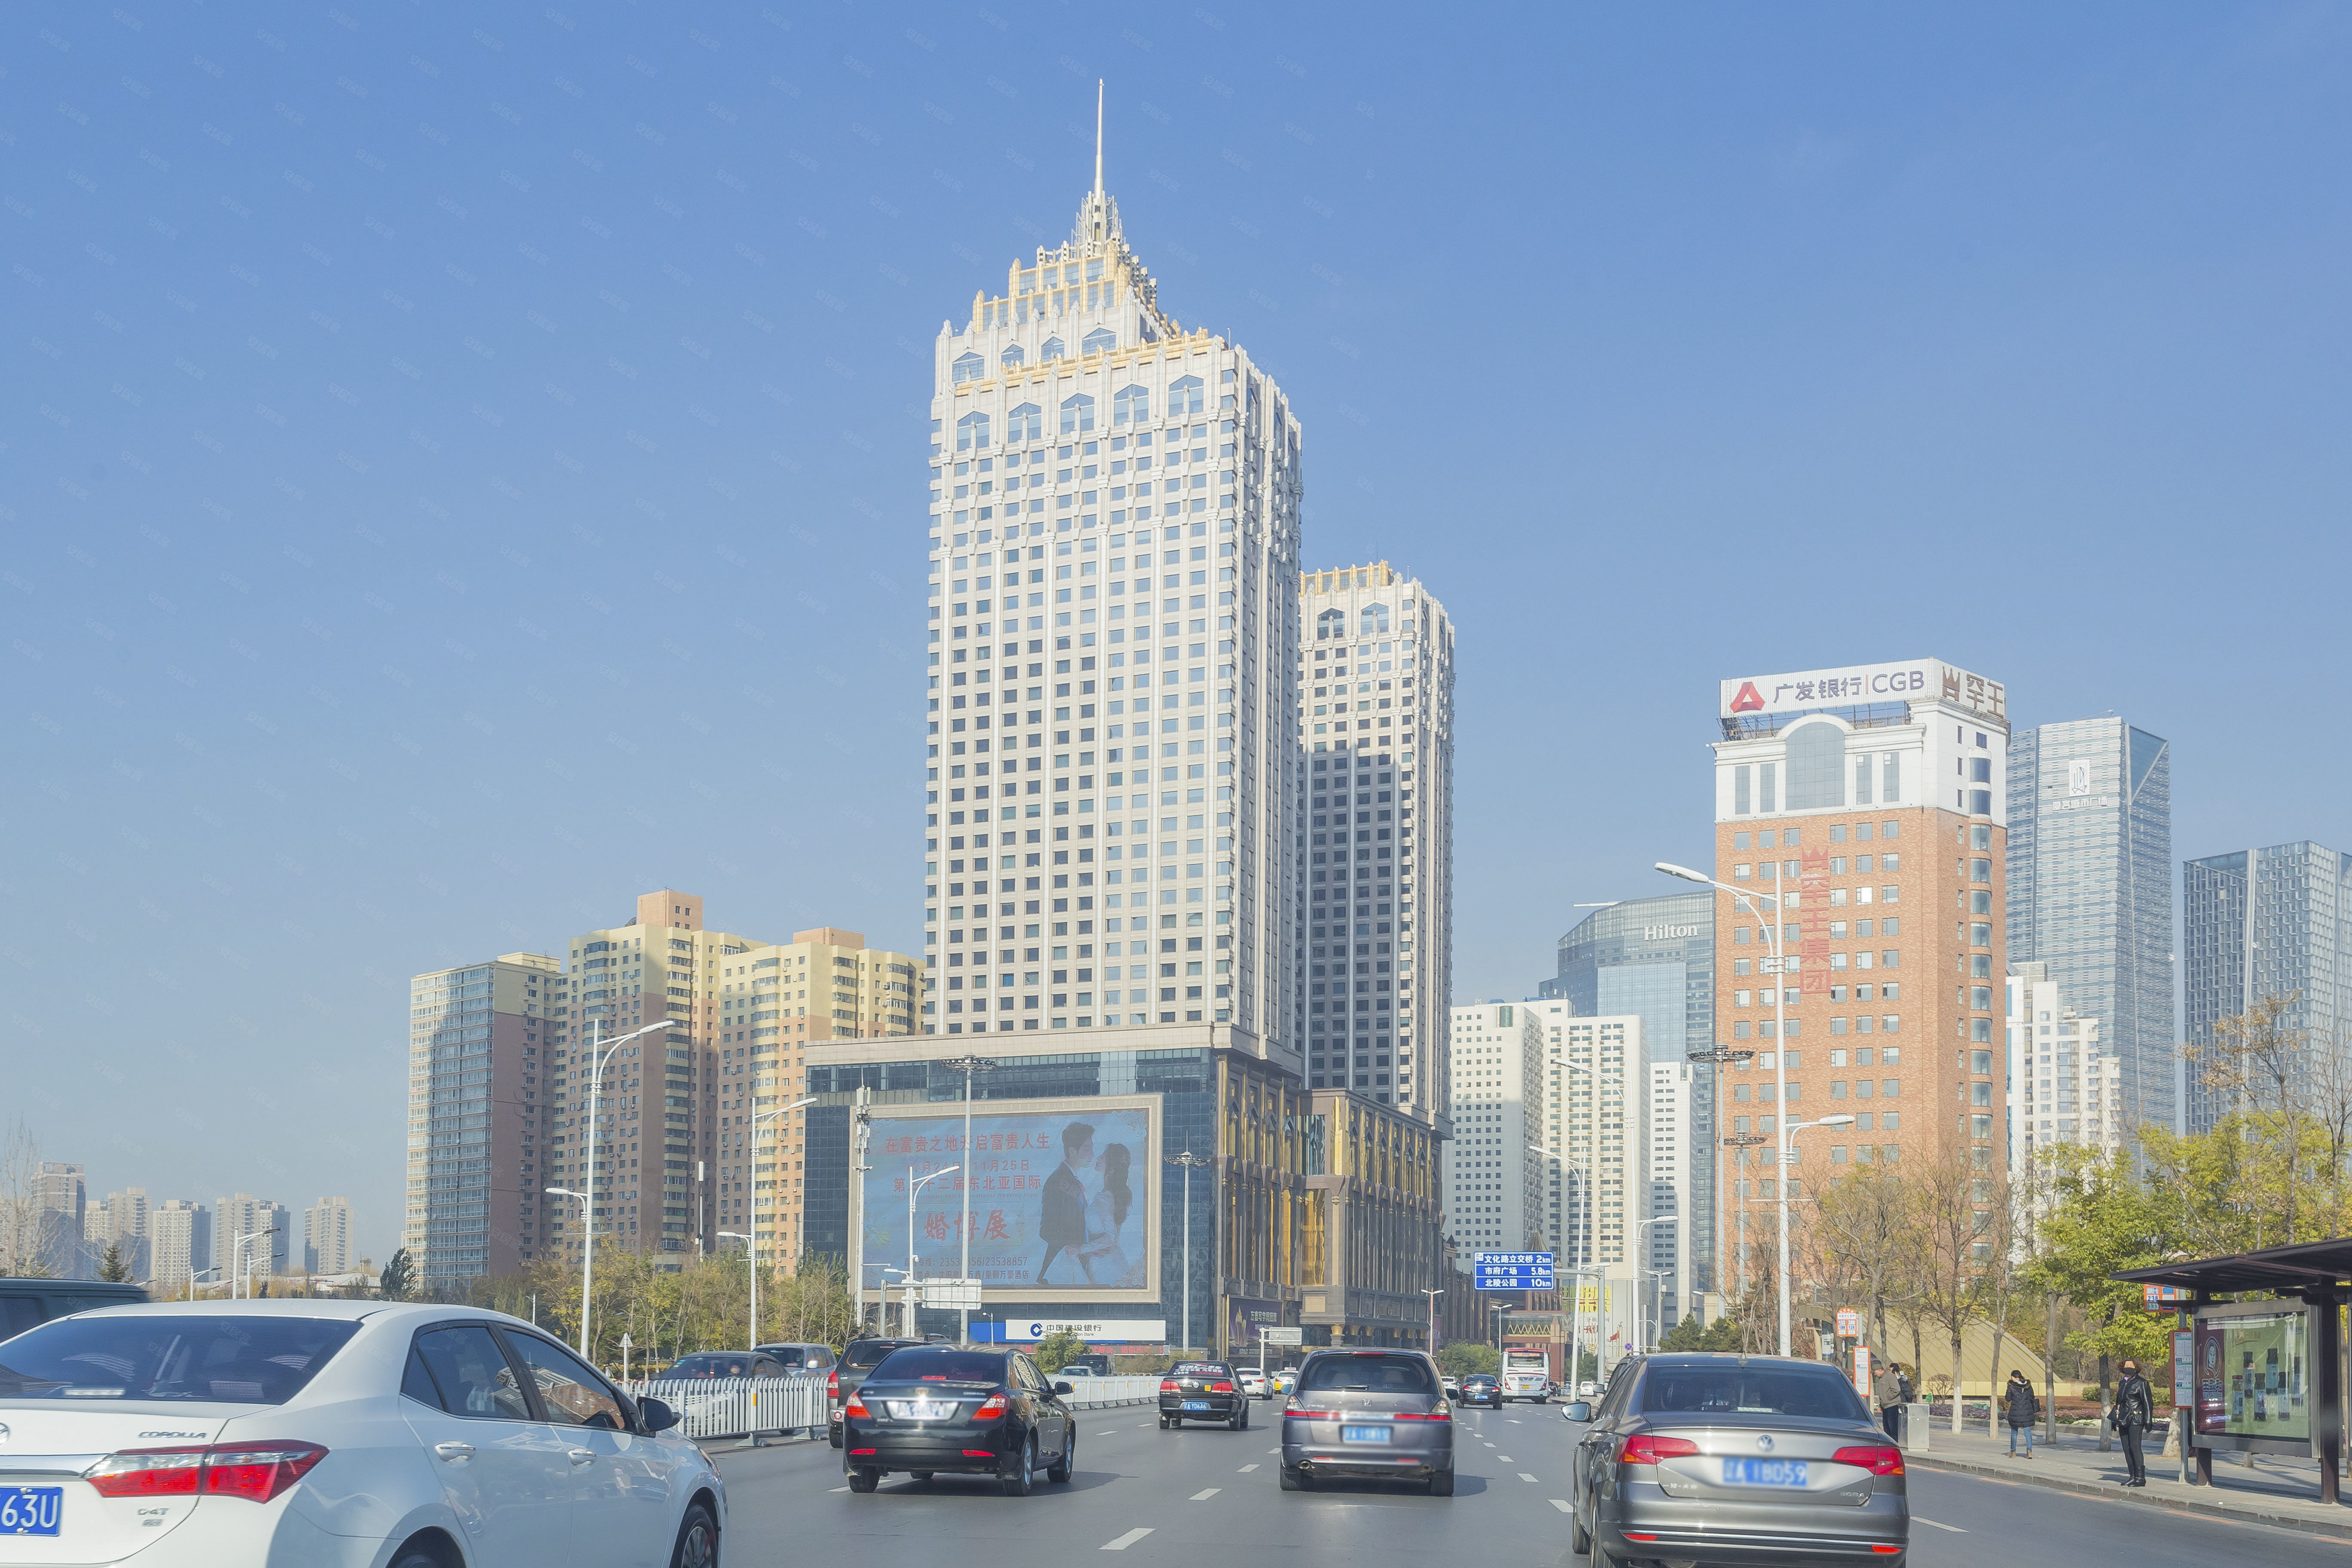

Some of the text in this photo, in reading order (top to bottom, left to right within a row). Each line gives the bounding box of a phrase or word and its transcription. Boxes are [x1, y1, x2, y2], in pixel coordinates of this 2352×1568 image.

[1872, 671, 1924, 693] CGB
[1774, 677, 1862, 703] 广发银行
[1644, 924, 1698, 940] Hilton
[973, 1159, 1029, 1172] 11月25日
[1484, 1255, 1551, 1264] 文化路立交桥 2km
[1485, 1267, 1551, 1275] 市府广场 5.8km
[1485, 1278, 1551, 1287] 北陵公园 10km
[0, 1494, 59, 1528] 63U
